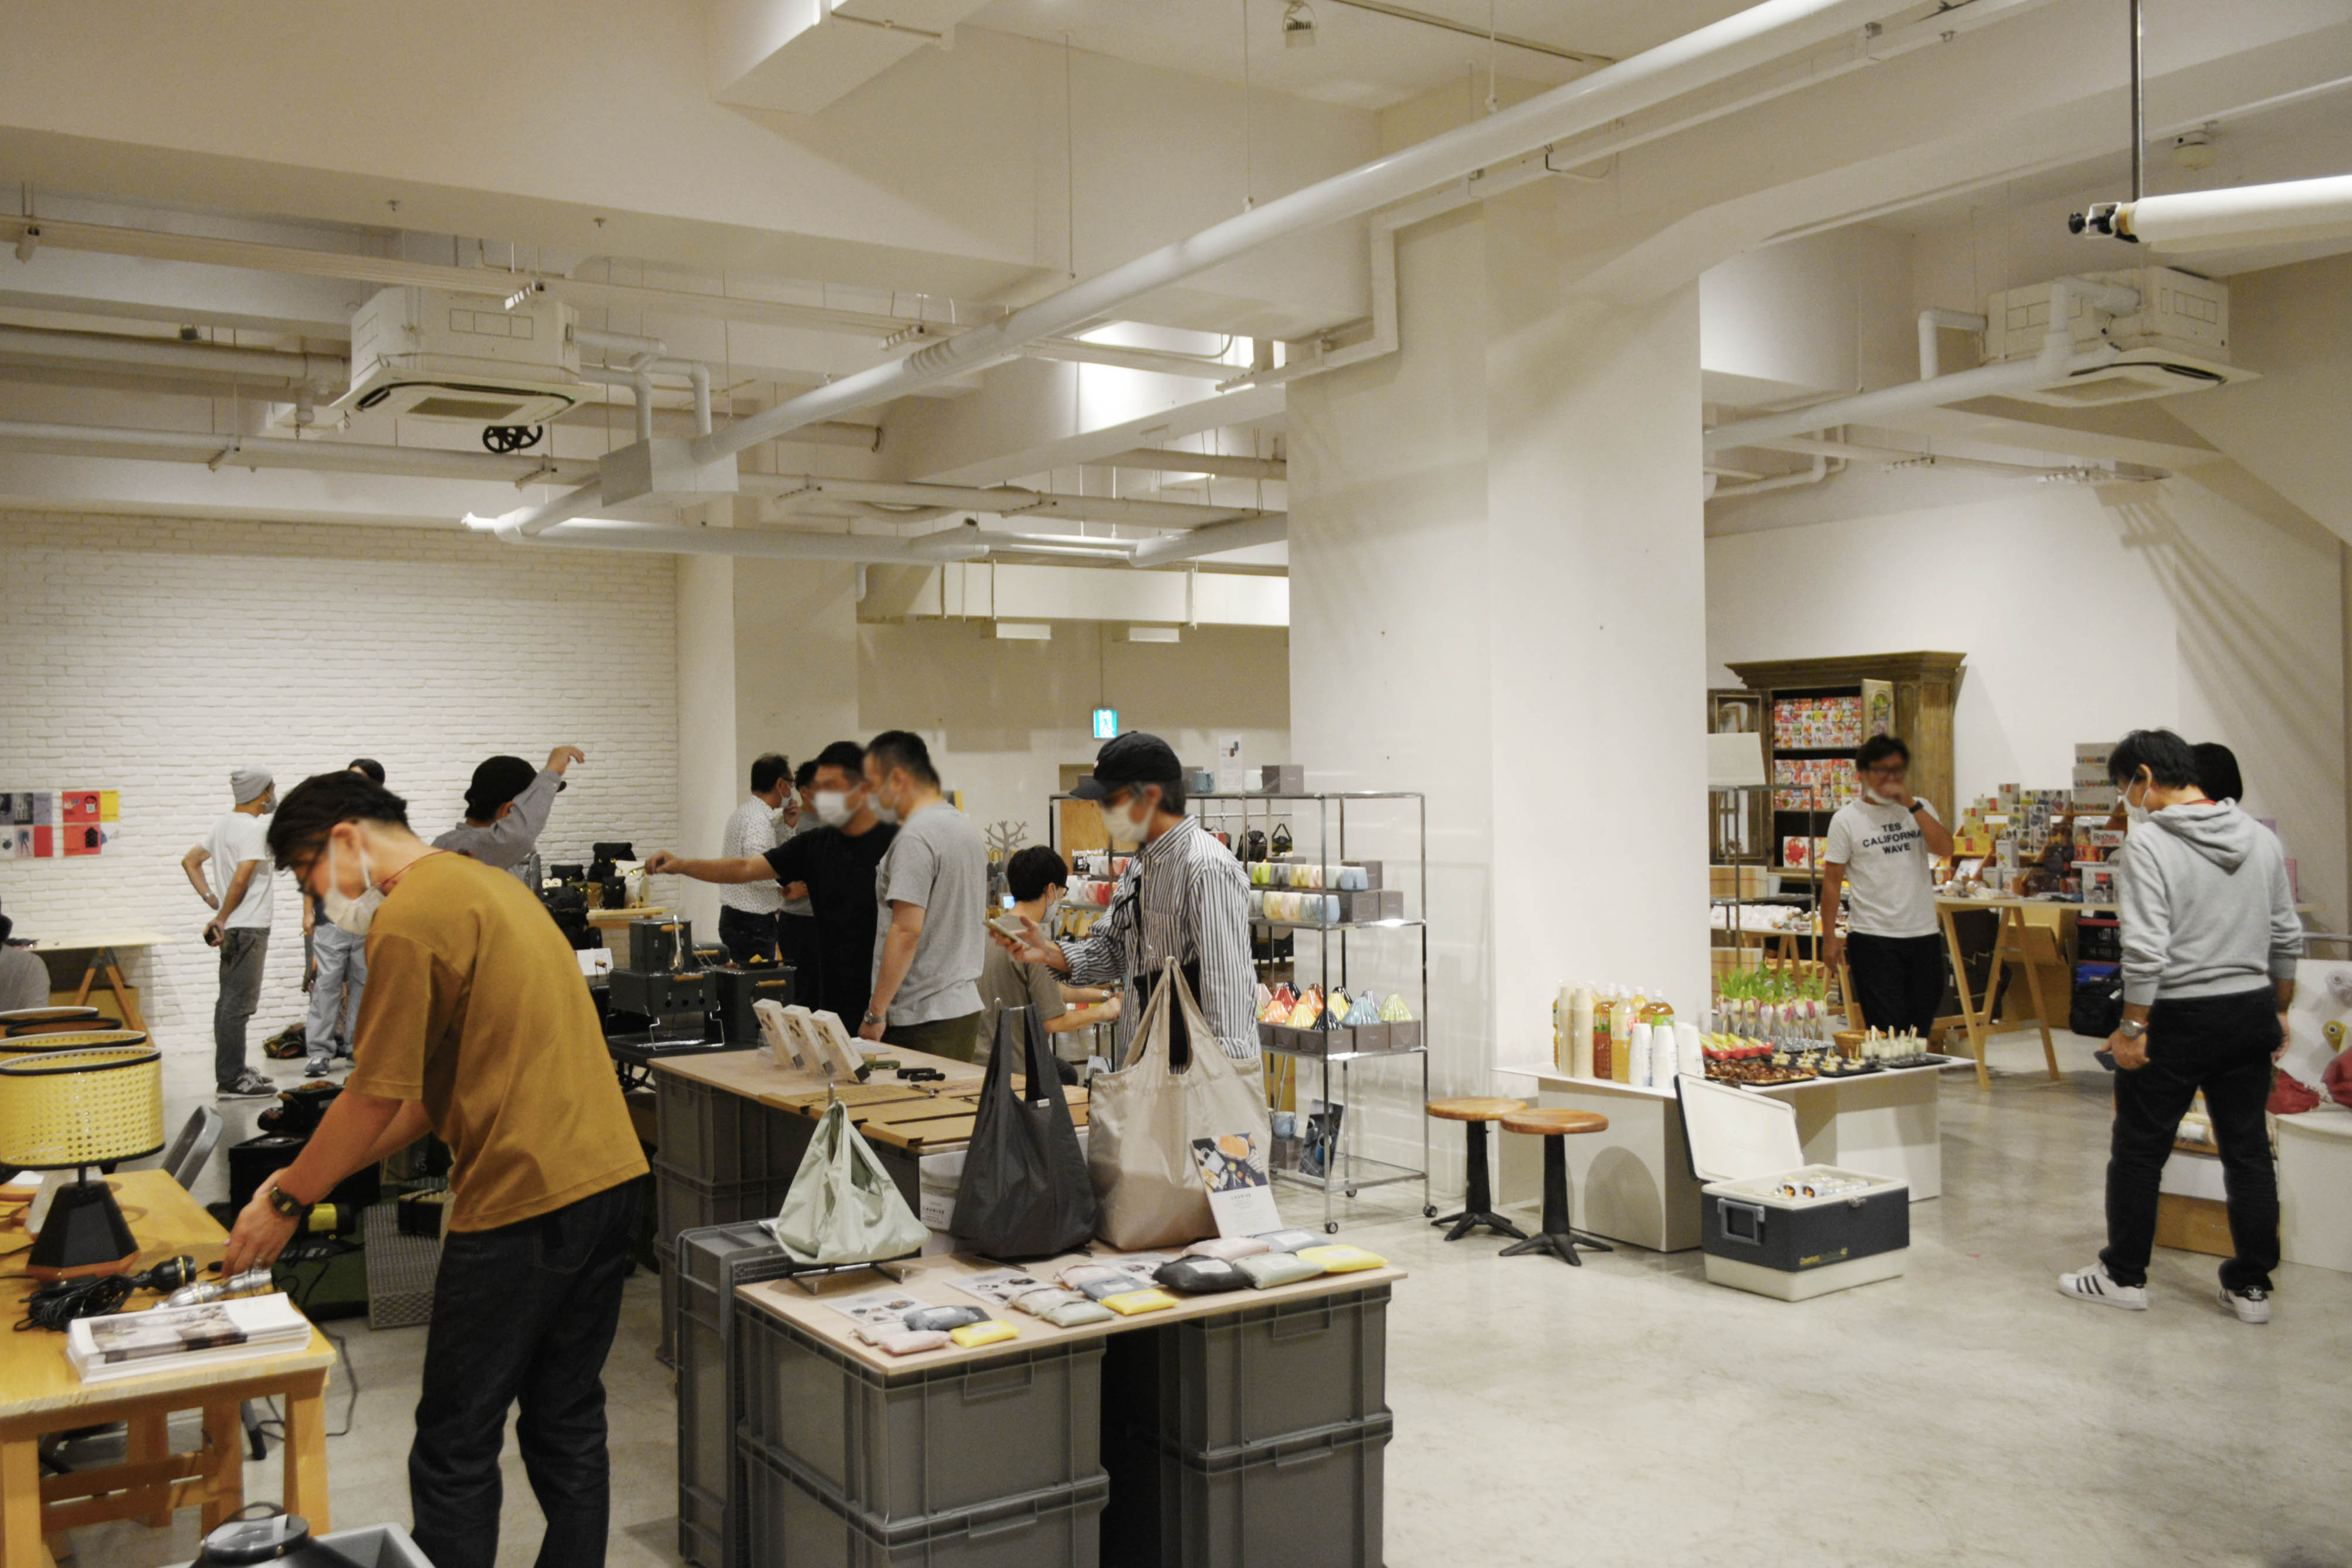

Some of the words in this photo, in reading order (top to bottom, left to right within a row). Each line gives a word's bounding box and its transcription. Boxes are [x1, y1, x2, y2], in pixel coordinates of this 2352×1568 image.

[1881, 822, 1902, 832] TES
[1862, 829, 1923, 848] CALIFORNIA
[1882, 842, 1910, 854] WAVE
